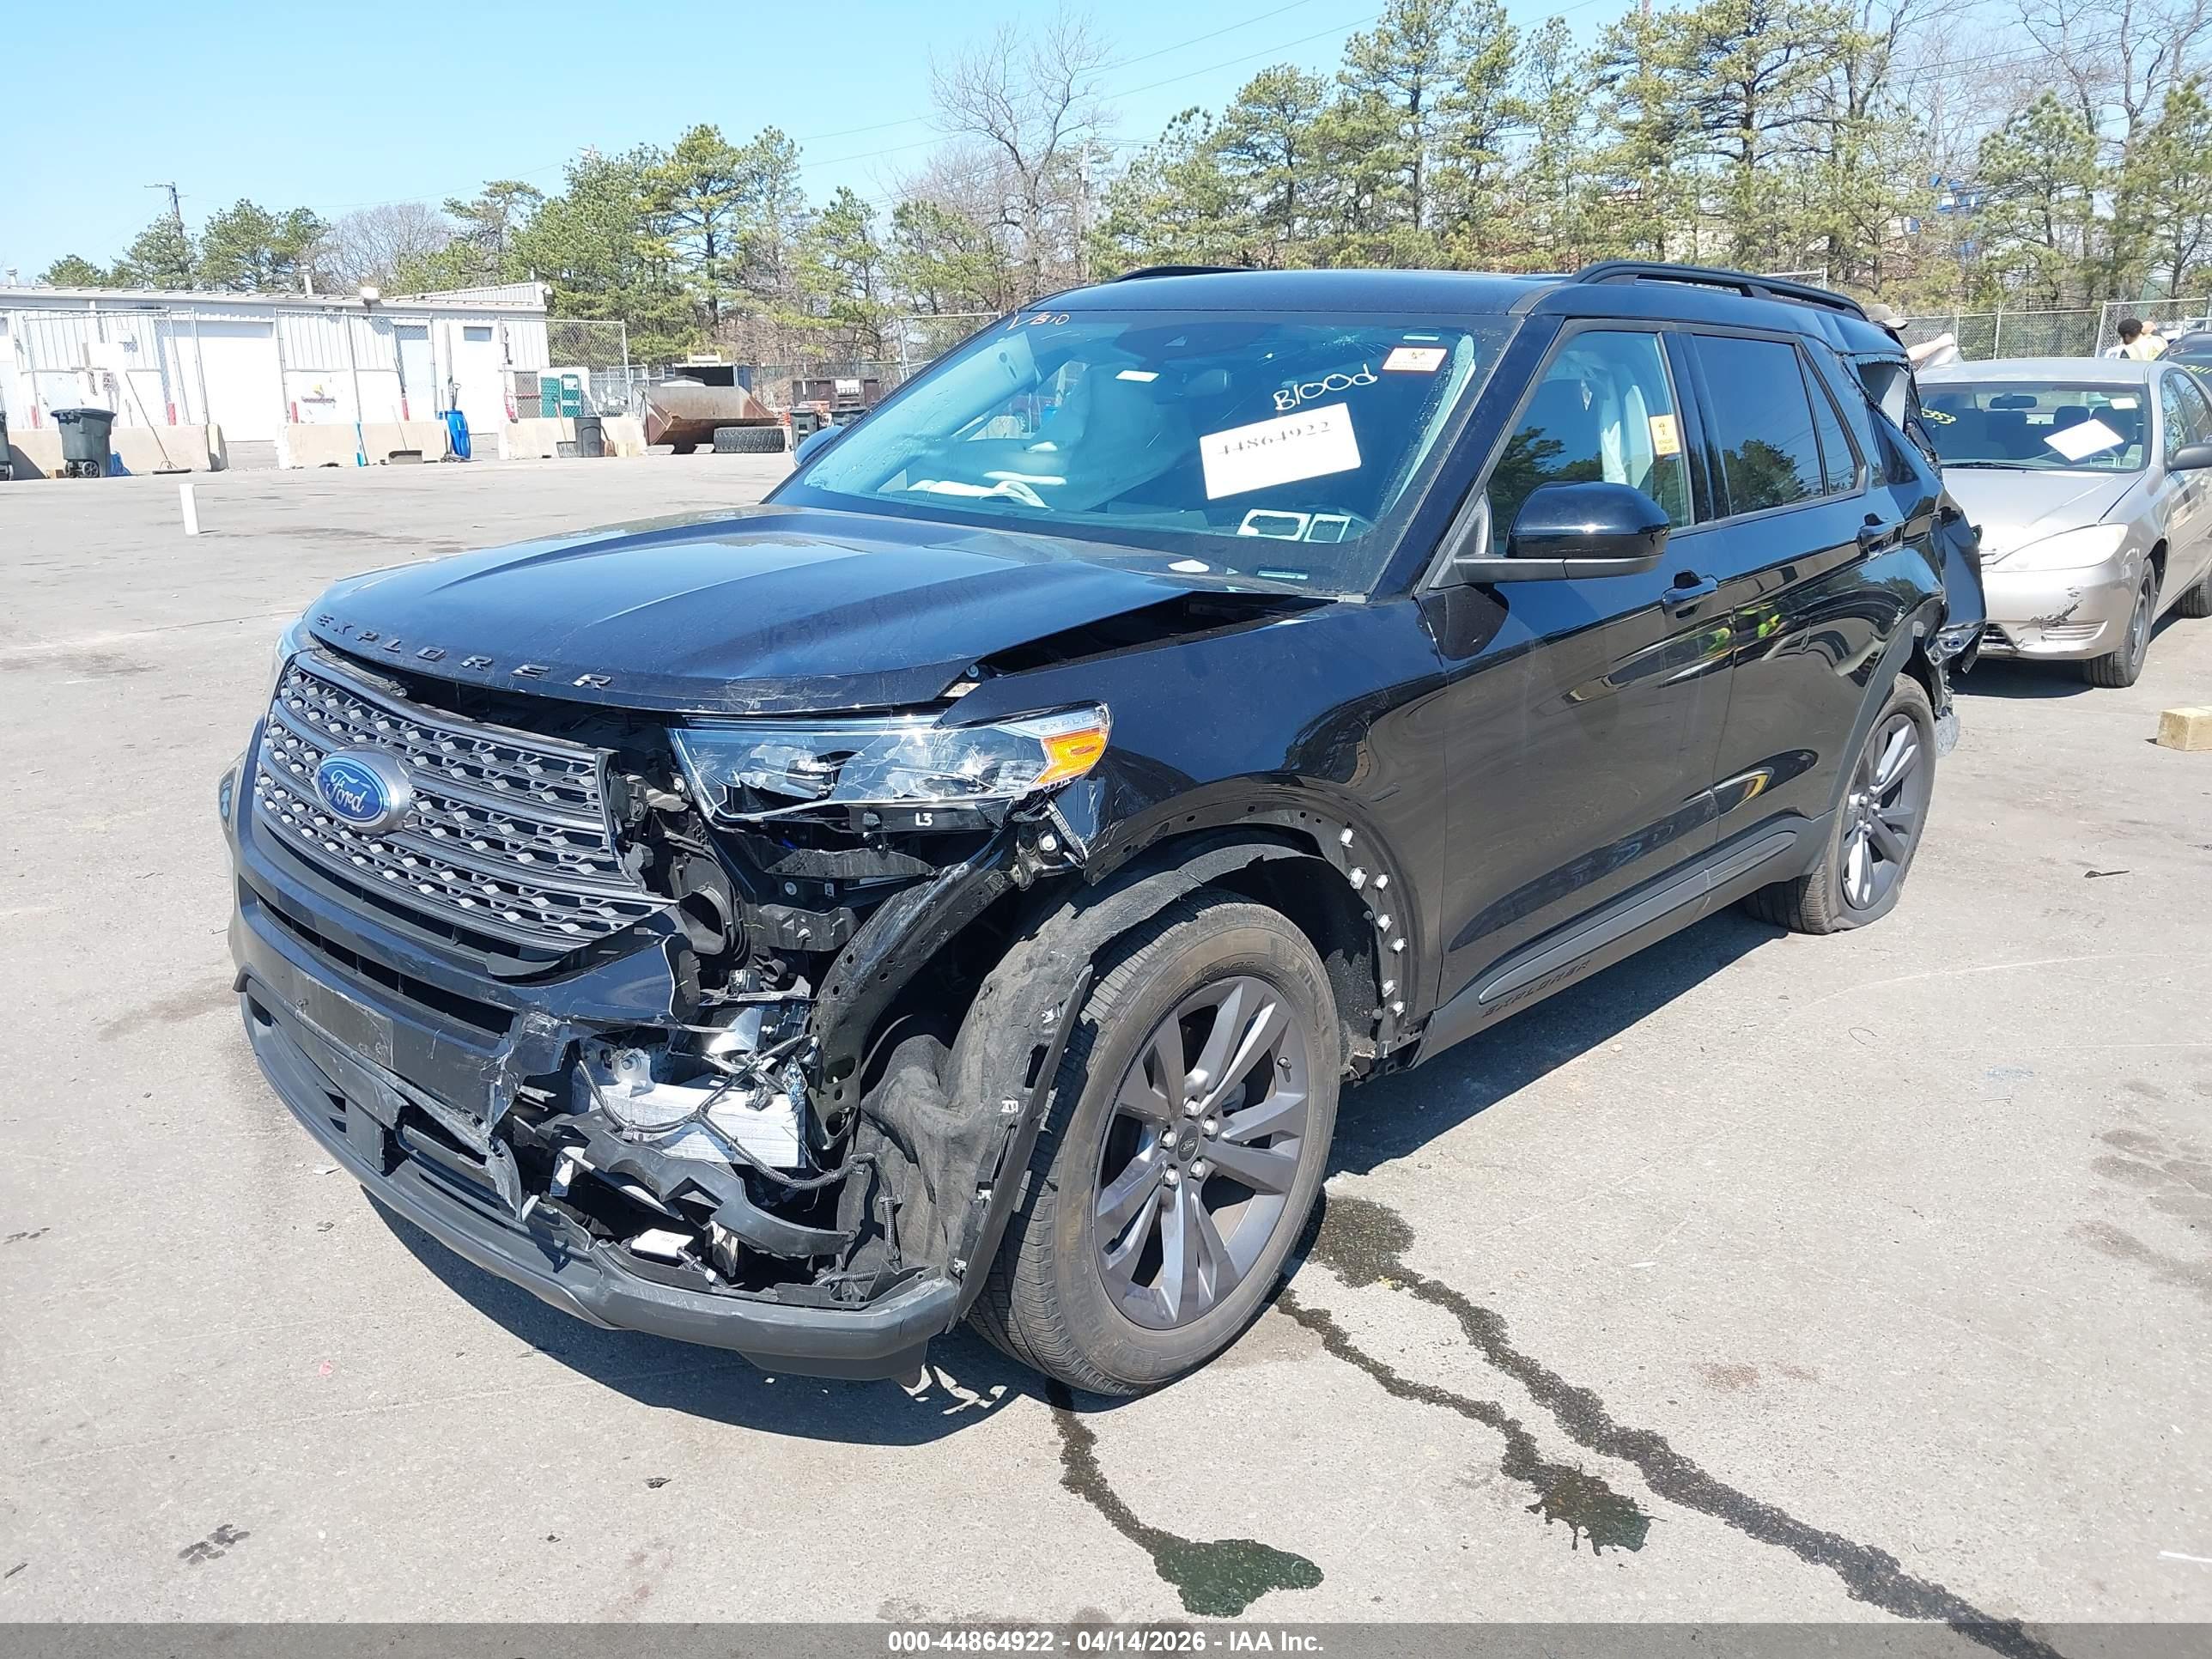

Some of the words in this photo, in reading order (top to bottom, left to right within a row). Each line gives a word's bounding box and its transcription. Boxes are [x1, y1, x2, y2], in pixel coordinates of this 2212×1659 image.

[1218, 422, 1332, 455] 44864922
[315, 612, 612, 690] EXPLORER
[326, 769, 368, 813] Ford
[915, 811, 933, 827] L3
